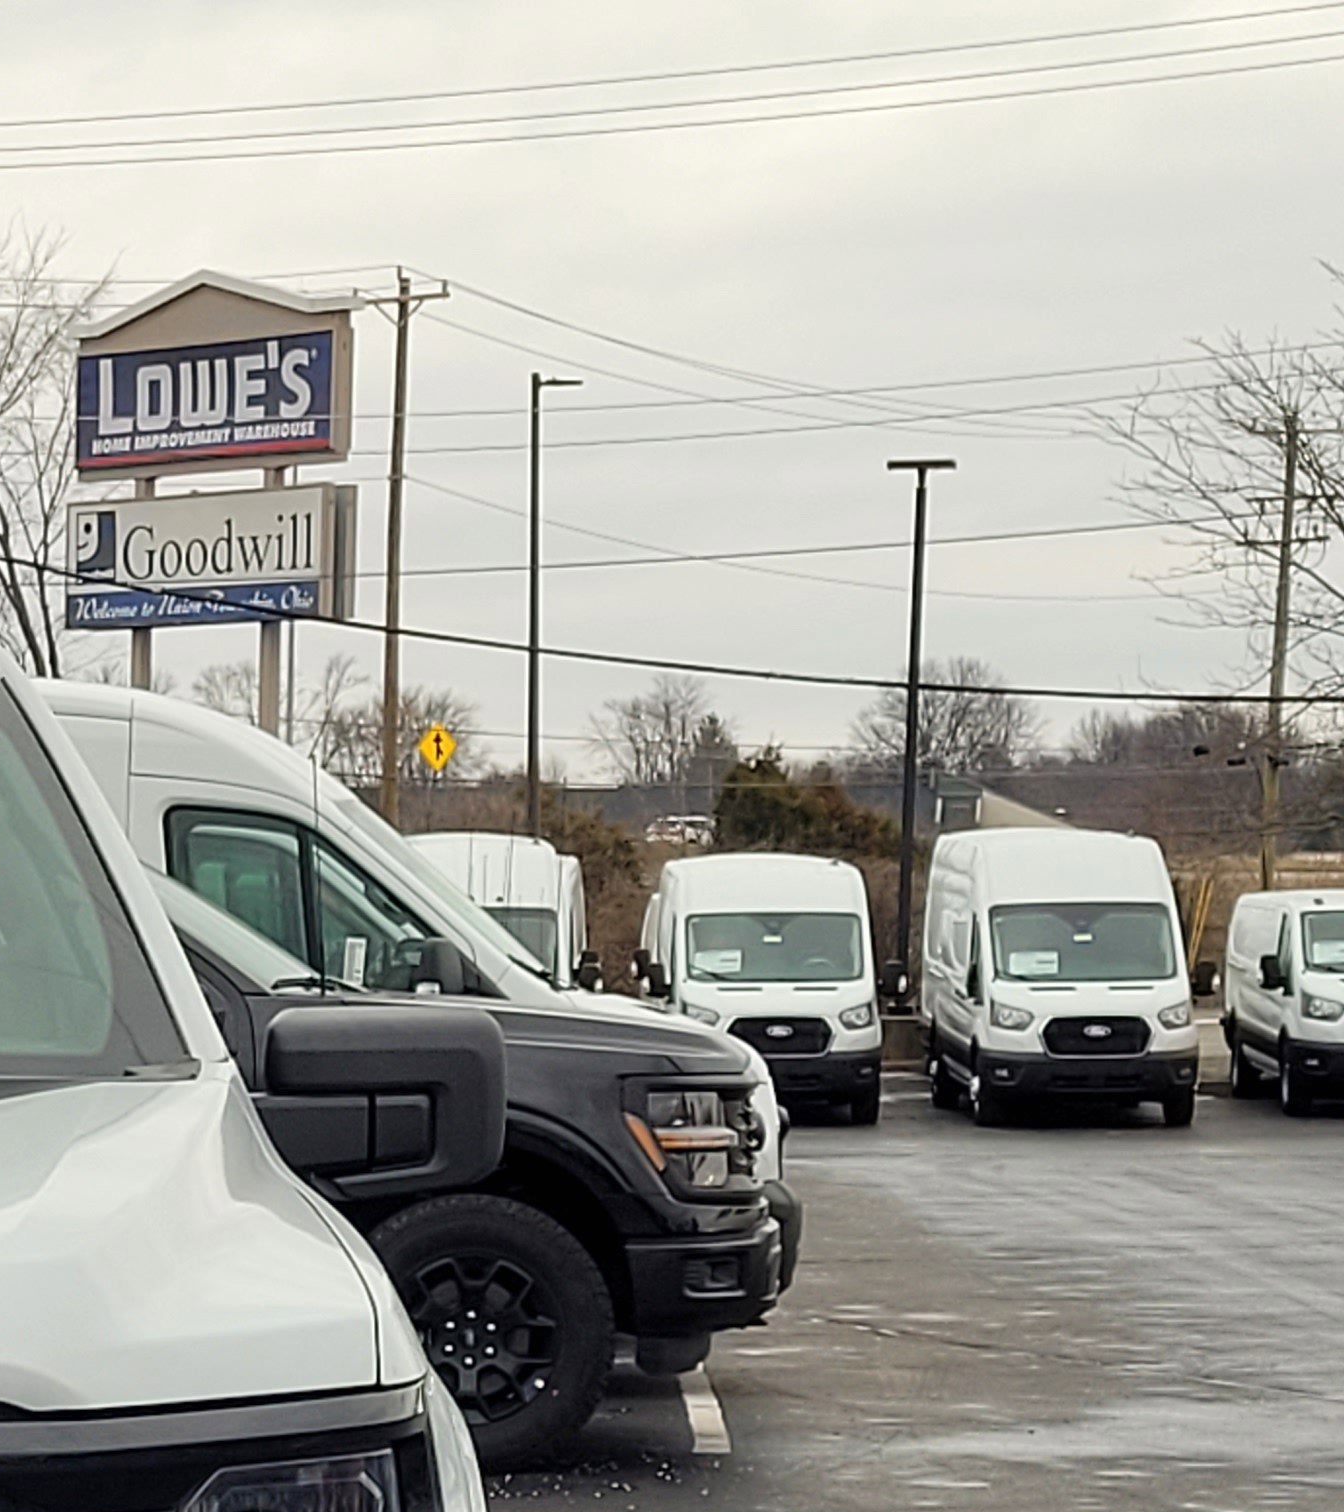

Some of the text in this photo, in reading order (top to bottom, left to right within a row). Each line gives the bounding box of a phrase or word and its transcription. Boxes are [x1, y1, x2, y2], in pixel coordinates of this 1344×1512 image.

[98, 341, 313, 436] LOWE'S
[92, 420, 316, 455] HOME IMPROVEMENT WAREHOUSE
[123, 512, 315, 580] Goodwill
[75, 598, 138, 621] Welcome
[141, 602, 156, 617] to
